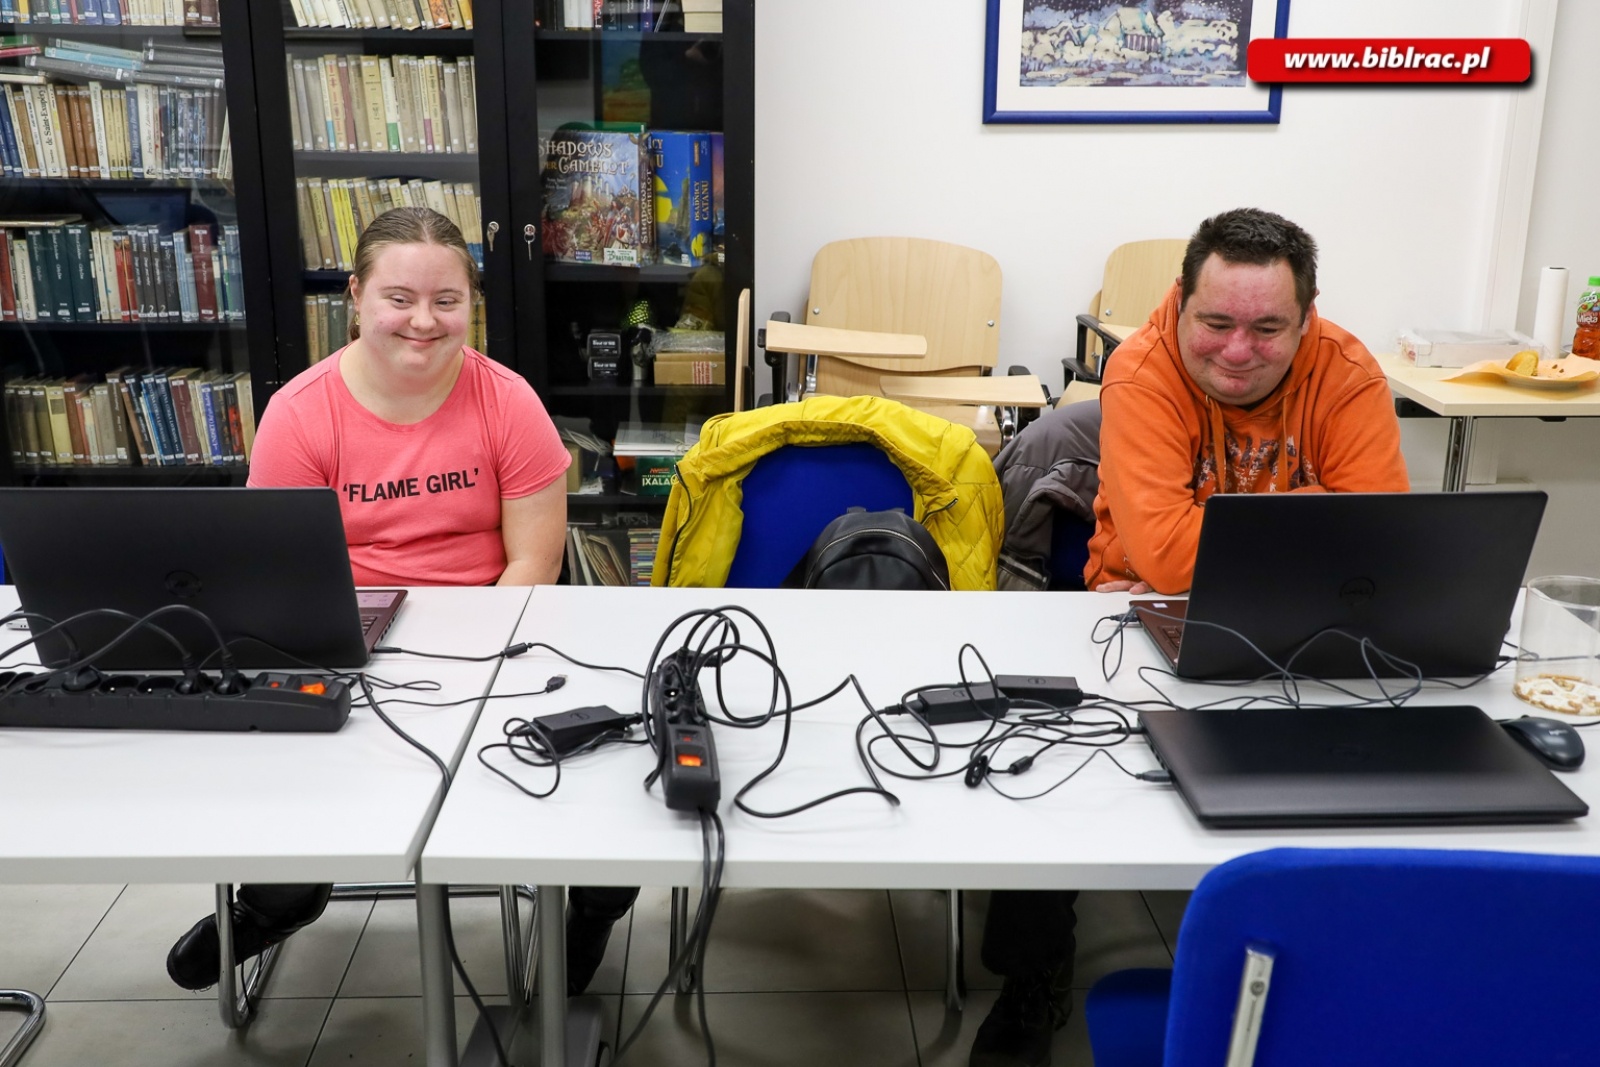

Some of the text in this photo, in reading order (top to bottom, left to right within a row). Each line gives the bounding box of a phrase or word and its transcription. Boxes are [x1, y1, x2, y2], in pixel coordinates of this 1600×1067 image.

[539, 137, 614, 158] SHADOWS
[558, 156, 631, 175] CAMELOT
[701, 181, 709, 221] CATANU
[642, 477, 671, 486] IXALA
